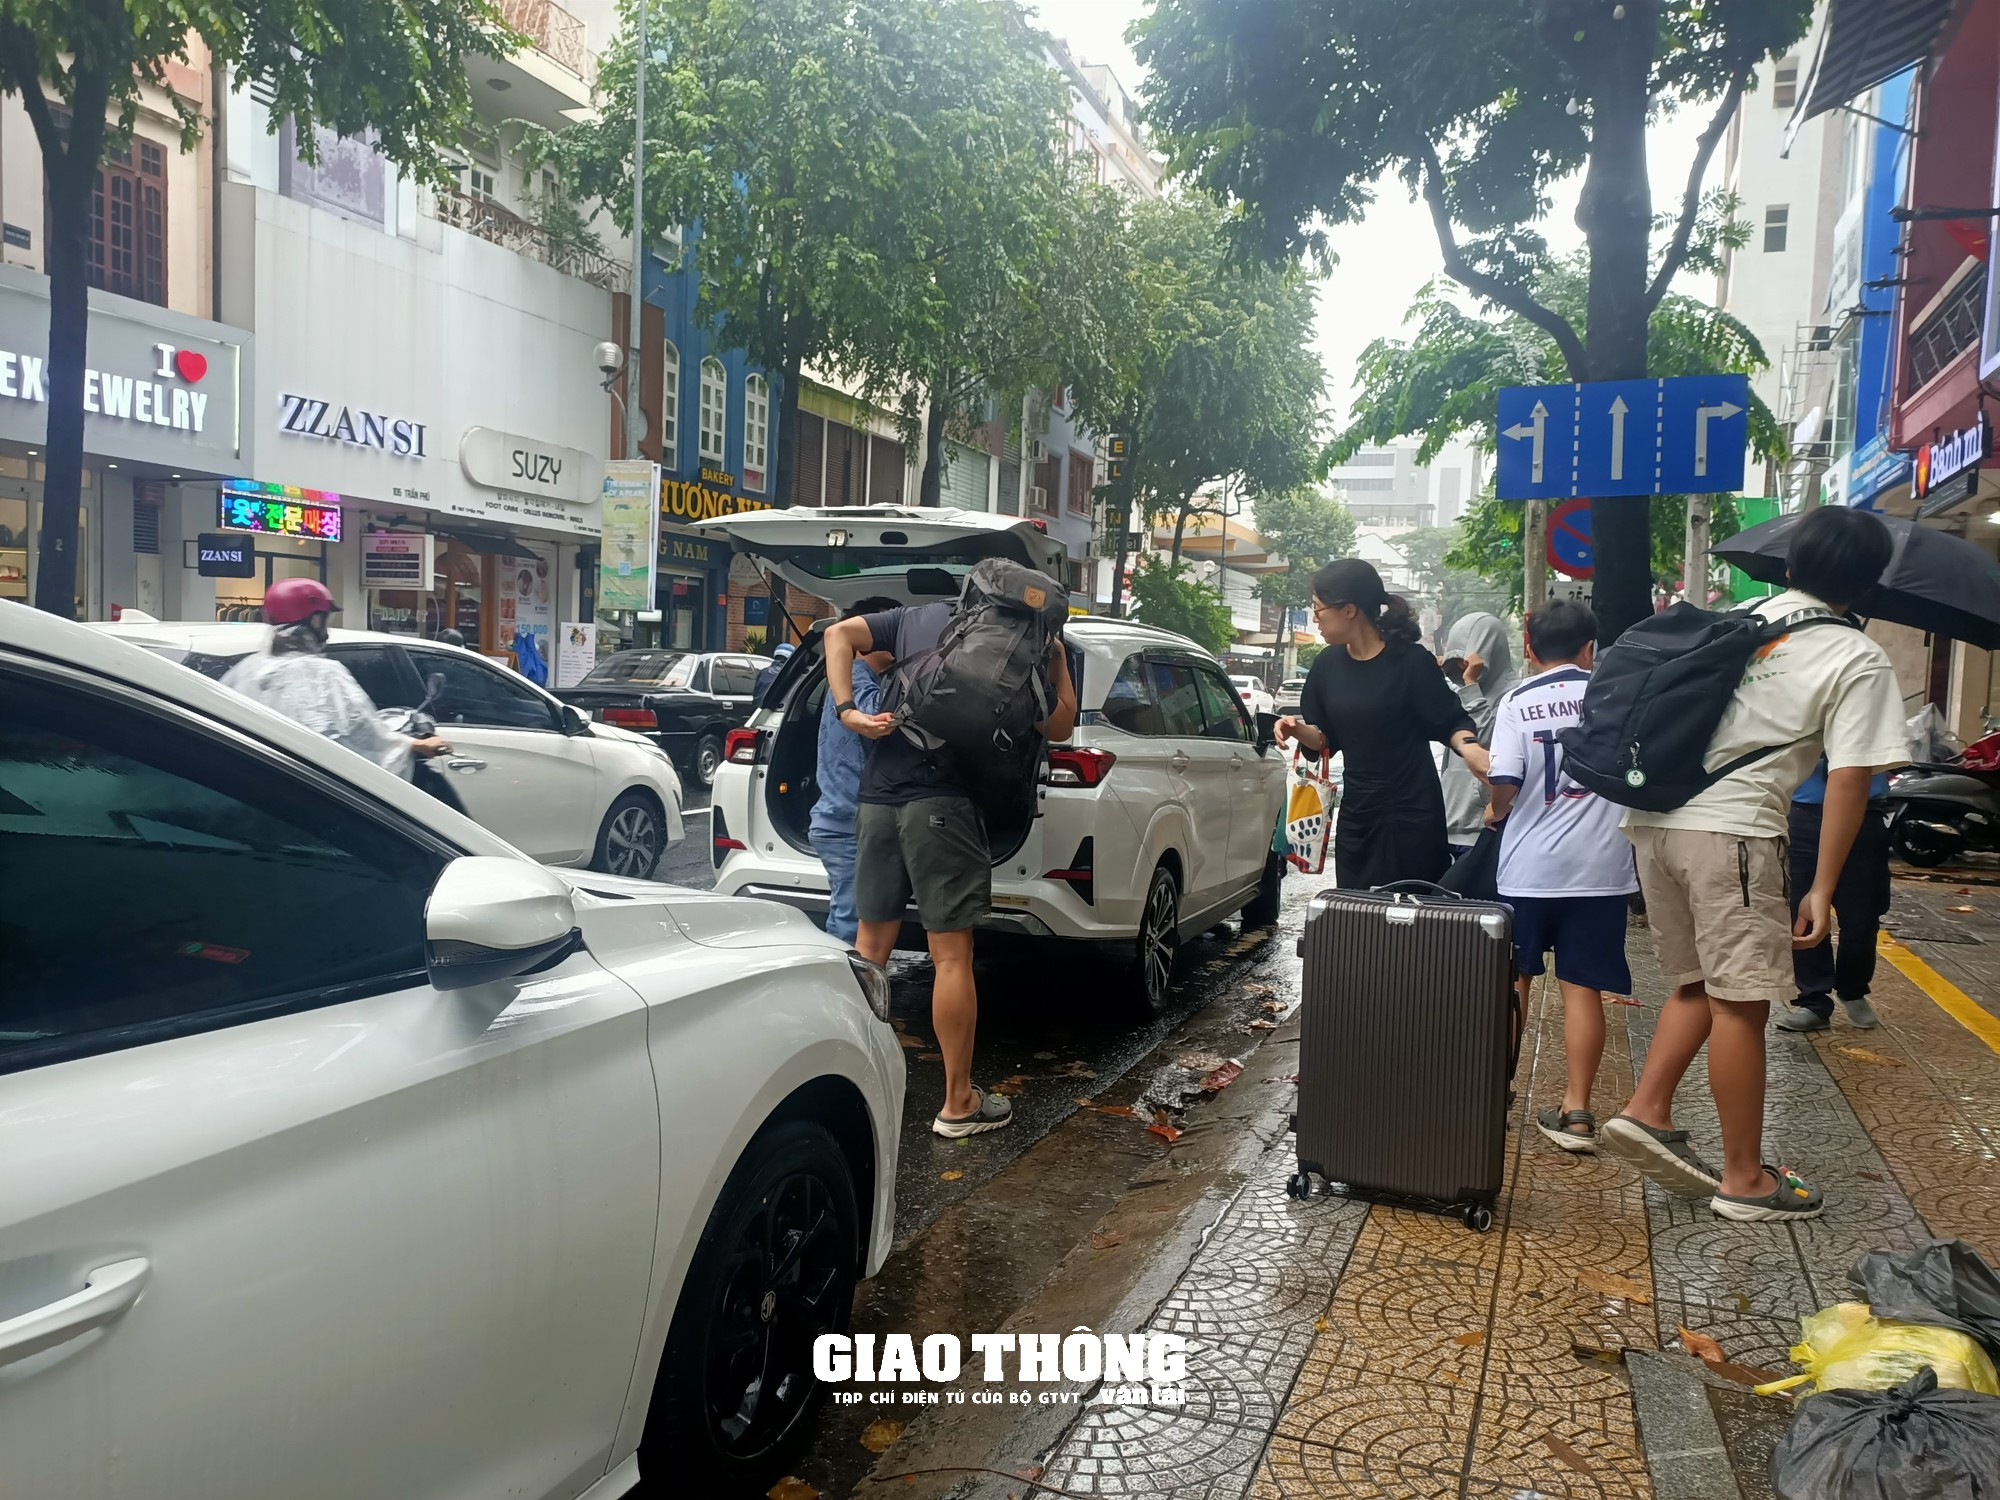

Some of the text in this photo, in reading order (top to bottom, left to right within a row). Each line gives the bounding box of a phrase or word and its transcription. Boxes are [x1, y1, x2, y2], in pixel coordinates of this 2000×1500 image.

[154, 343, 175, 378] I
[83, 369, 208, 432] EWELRY
[281, 394, 427, 458] ZZANSI
[512, 449, 563, 485] SUZY
[1928, 429, 1962, 489] Bánh
[701, 467, 736, 487] BAKERY
[660, 479, 734, 520] HƯƠNG
[265, 502, 338, 537] 전문매장
[201, 549, 243, 563] ZZANSI
[673, 540, 709, 562] NAM
[1520, 704, 1546, 722] LEE
